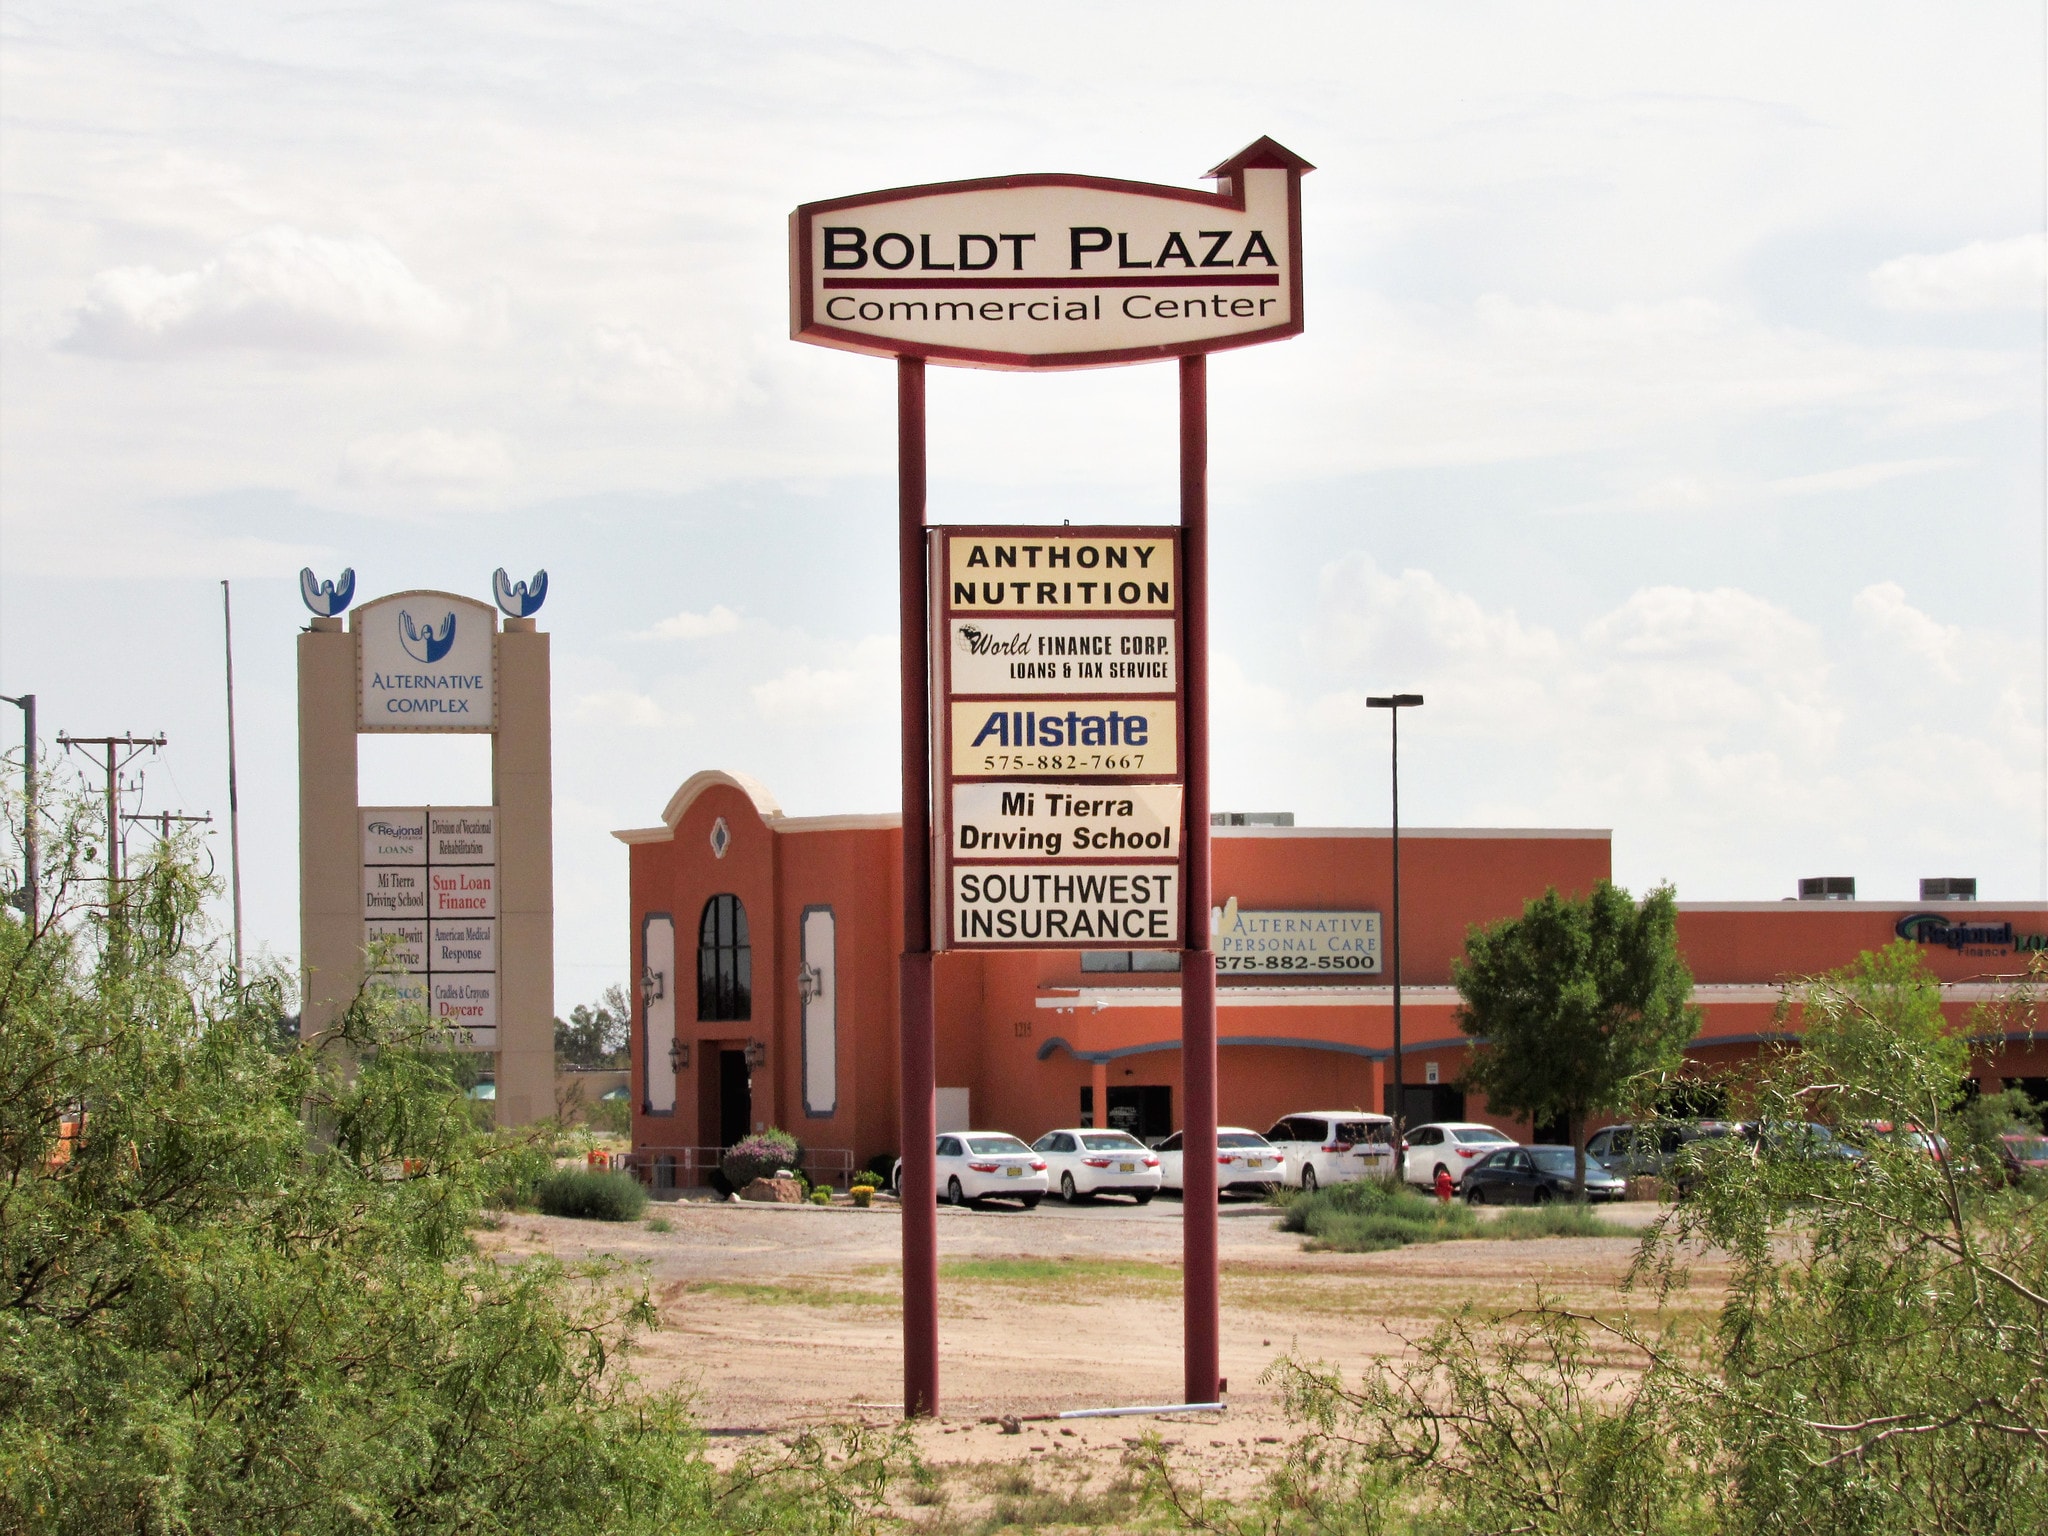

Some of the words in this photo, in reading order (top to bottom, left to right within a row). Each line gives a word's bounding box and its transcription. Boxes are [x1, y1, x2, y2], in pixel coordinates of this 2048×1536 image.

[822, 226, 1036, 272] BOLDT
[1069, 226, 1279, 270] PLAZA
[826, 296, 1100, 322] Commercial
[1122, 295, 1277, 319] Center
[967, 545, 1156, 568] ANTHONY
[954, 582, 1169, 604] NUTRITION
[970, 633, 1032, 656] World
[1038, 636, 1112, 655] FINANCE
[1120, 636, 1169, 655] CORP.
[1010, 662, 1056, 679] LOANS
[1063, 662, 1072, 678] &
[1078, 662, 1103, 678] TAX
[1109, 662, 1168, 678] SERVICE
[372, 673, 483, 690] ALTERNATIVE
[387, 699, 469, 713] COMPLEX
[971, 711, 1148, 747] Allstate
[984, 755, 1145, 770] 575-882-7667
[1001, 792, 1034, 817] Mi
[1045, 793, 1134, 817] Tierra
[378, 825, 423, 838] Regional
[432, 820, 456, 834] Division
[456, 819, 464, 834] of
[463, 819, 491, 834] Vocational
[439, 840, 483, 855] Rehabilitation
[960, 825, 1062, 855] Driving
[1072, 826, 1171, 850] School
[378, 846, 413, 854] LOANS
[378, 873, 389, 888] Mi
[391, 873, 415, 888] Tierra
[433, 875, 456, 890] Sun
[460, 874, 491, 890] Loan
[960, 874, 1172, 904] SOUTHWEST
[367, 892, 397, 911] Driving
[398, 892, 424, 907] School
[439, 893, 486, 909] Finance
[961, 909, 1169, 938] INSURANCE
[1233, 914, 1375, 936] ALTERNATIVE
[435, 927, 465, 941] American
[466, 926, 490, 940] Medical
[1918, 922, 2012, 949] Regional
[442, 946, 482, 963] Response
[1223, 937, 1317, 951] PERSONAL
[1328, 937, 1376, 955] CARE
[1216, 956, 1375, 969] 575-882-5500
[435, 985, 458, 999] Cradles
[459, 986, 464, 998] &
[465, 985, 489, 1002] Crayons
[440, 1002, 484, 1019] Daycare
